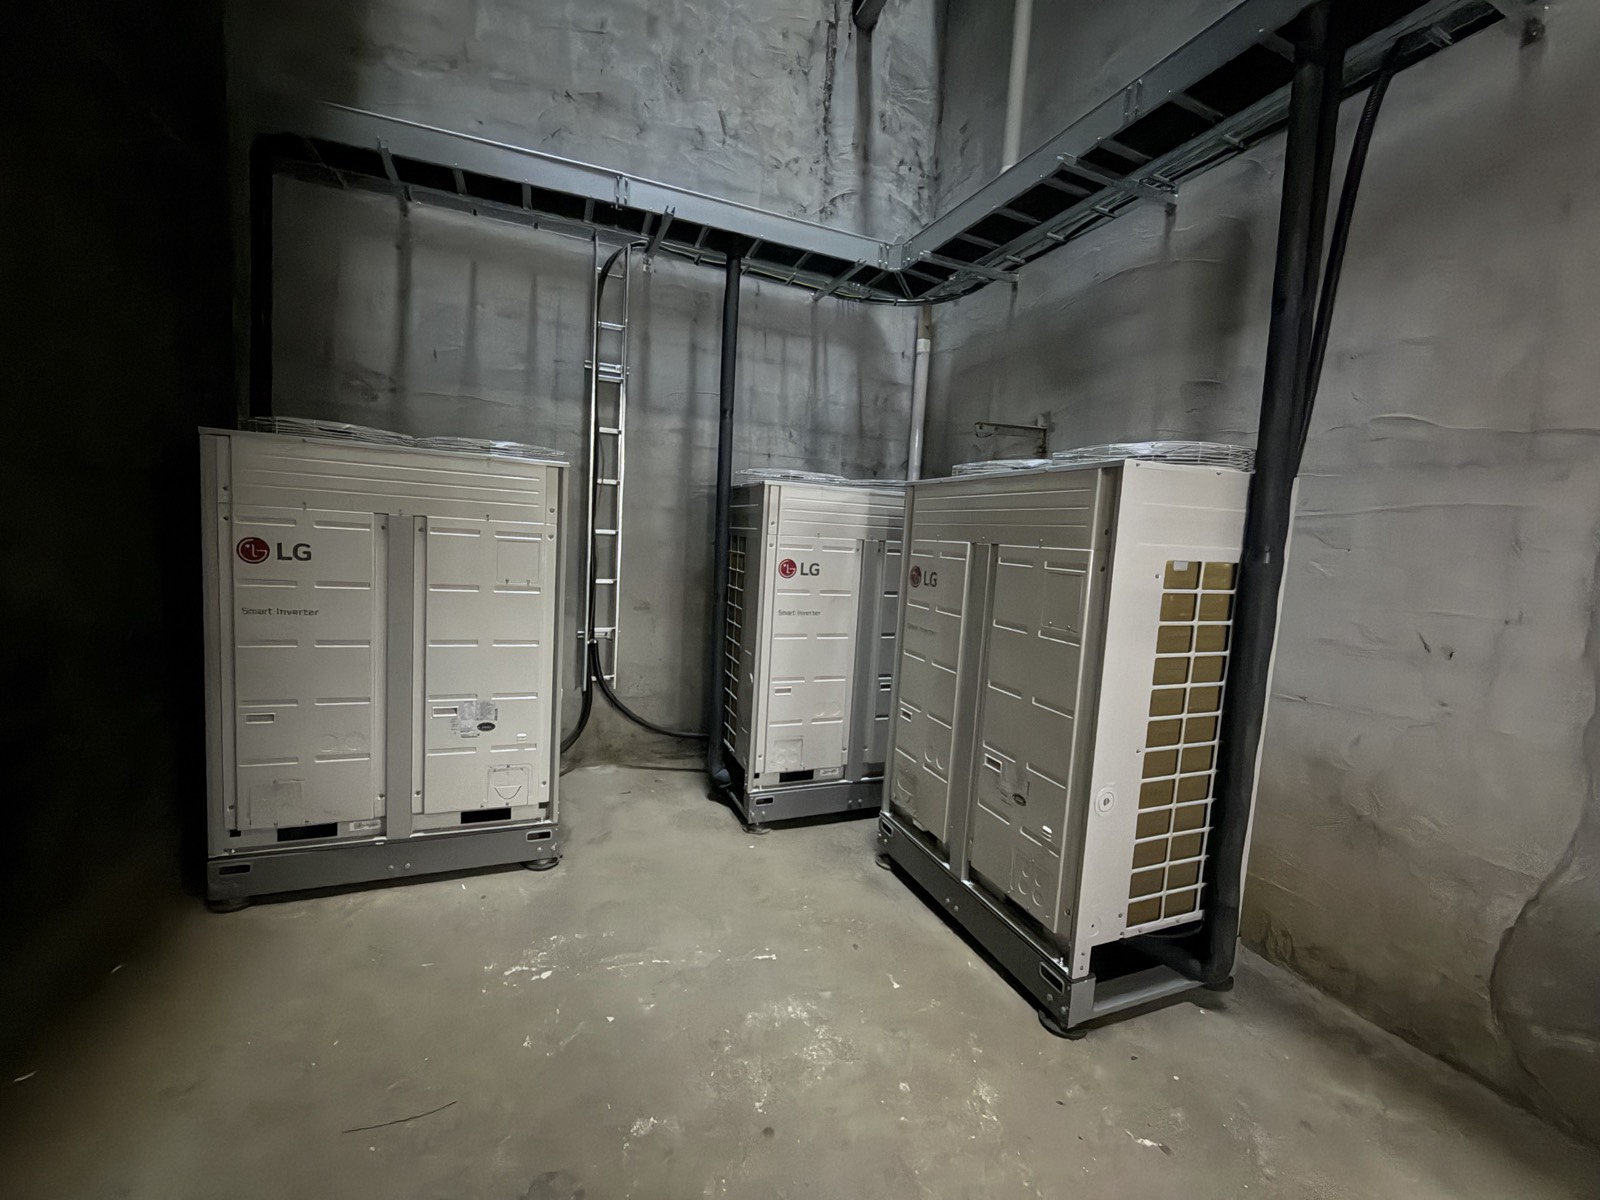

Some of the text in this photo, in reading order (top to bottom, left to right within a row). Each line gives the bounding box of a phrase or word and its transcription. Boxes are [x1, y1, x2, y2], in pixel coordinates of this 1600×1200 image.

[276, 542, 312, 561] LG
[800, 562, 820, 576] LG
[923, 570, 938, 587] LG
[241, 607, 320, 616] Smart Inverter
